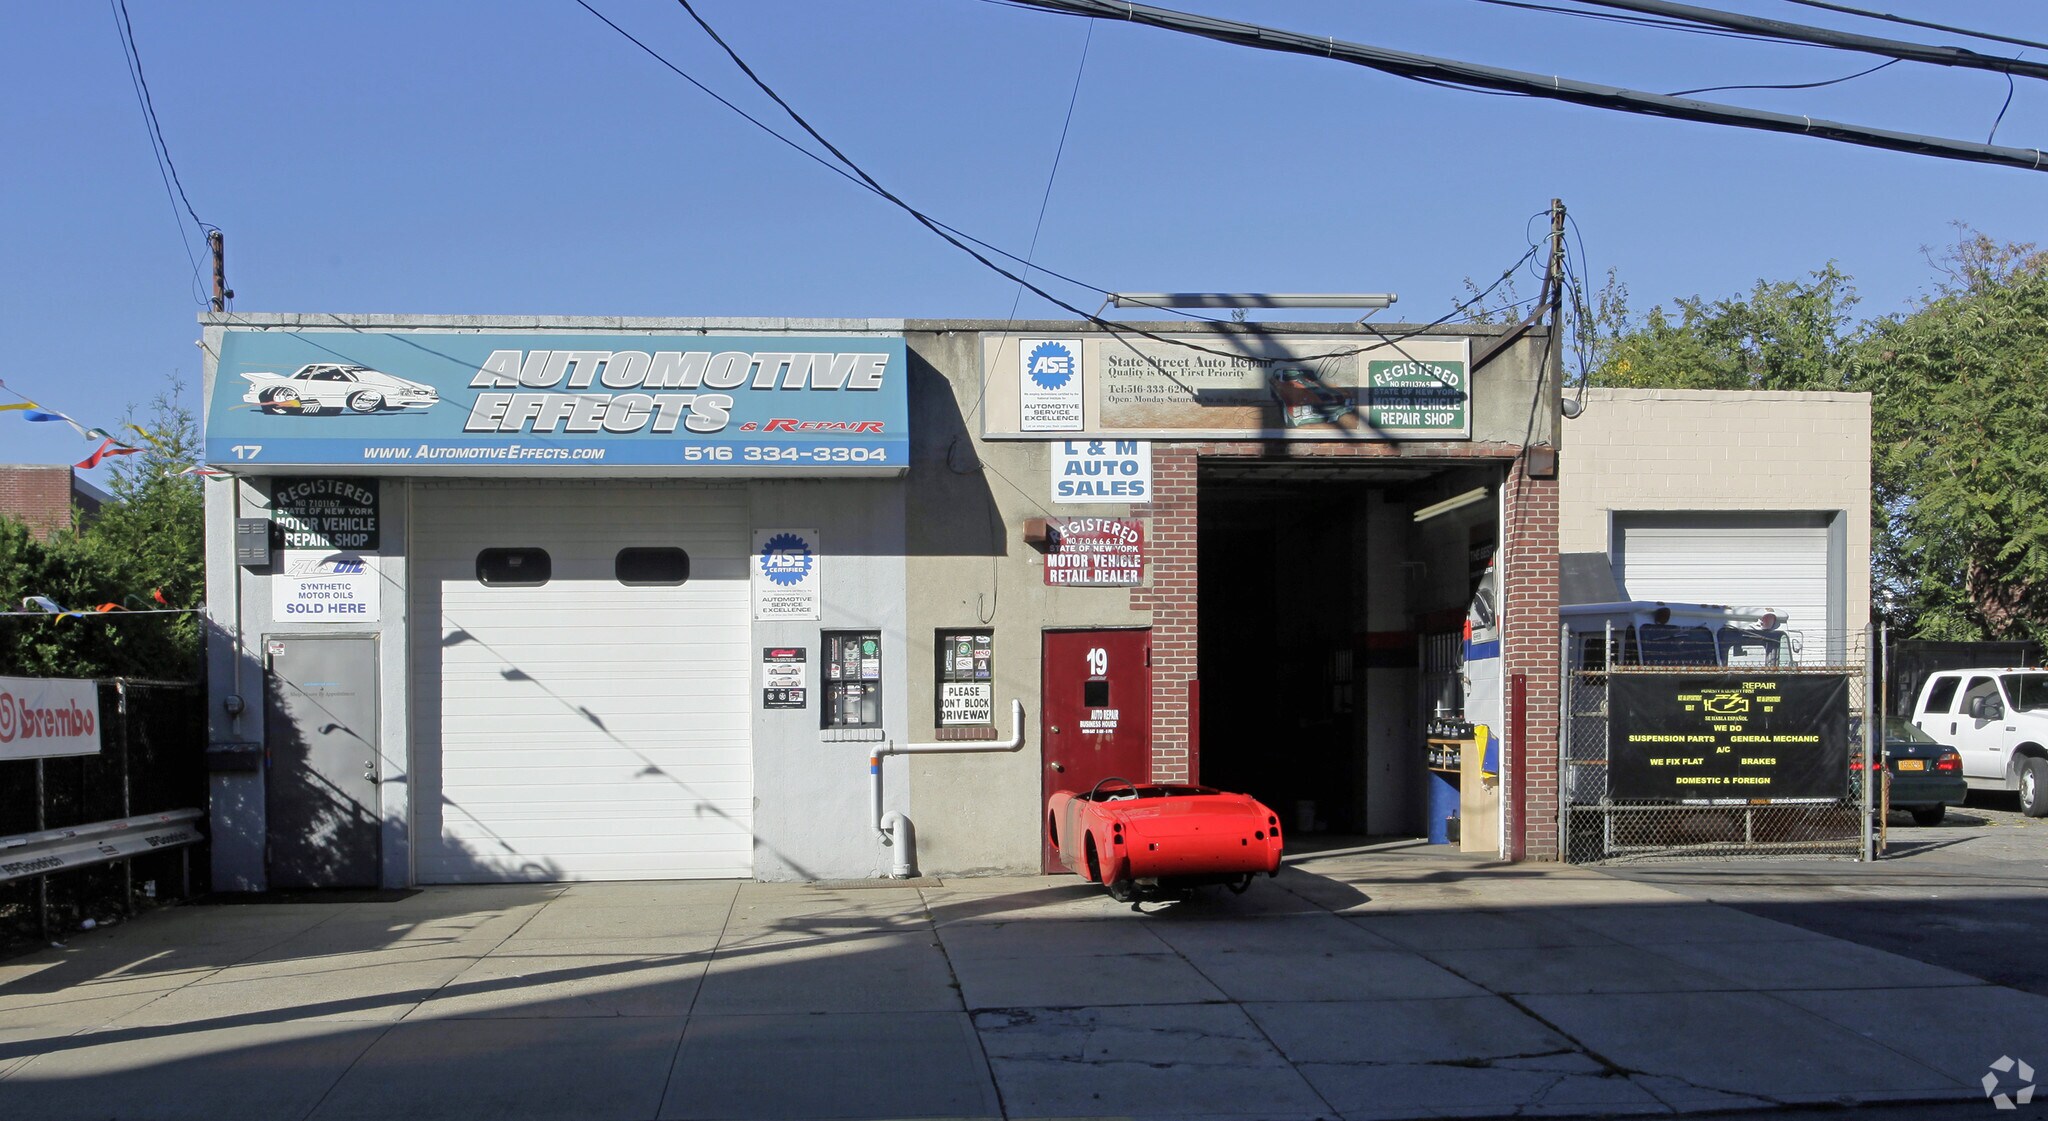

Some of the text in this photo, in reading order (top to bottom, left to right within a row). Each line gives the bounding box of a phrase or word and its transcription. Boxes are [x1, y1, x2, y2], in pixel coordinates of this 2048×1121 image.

[467, 348, 890, 390] AUTOMOTIVE
[1032, 356, 1069, 374] ASE
[1108, 355, 1275, 372] State Street Auto Repair
[1108, 367, 1246, 379] Quality is Our First Priority
[1373, 362, 1460, 387] REGISTERED
[1108, 384, 1194, 394] Tel:516-333-6200
[1108, 395, 1133, 404] Open:
[1373, 397, 1461, 411] MOTOR VEHICLE
[462, 392, 735, 434] EFFECTS
[738, 422, 758, 432] &
[1381, 412, 1455, 425] REPAIR SHOP
[231, 445, 262, 460] 17
[684, 446, 887, 462] 516 334-3304
[1064, 440, 1138, 456] L & M
[1064, 460, 1139, 476] AUTO
[276, 479, 374, 506] REGISTERED
[1057, 480, 1146, 496] SALES
[277, 507, 374, 515] STATE OF NEW YORK
[309, 500, 341, 508] 7101167
[276, 517, 375, 531] MOTOR VEHICLE
[1049, 518, 1139, 543] REGISTERED
[285, 533, 369, 547] REPAIR SHOP
[1115, 545, 1139, 553] YORK
[766, 549, 805, 567] ASE
[1047, 554, 1141, 568] MOTOR VEHICLE
[1050, 569, 1139, 583] RETAIL DEALER
[286, 603, 367, 614] SOLD HERE
[1086, 648, 1108, 675] 19
[949, 686, 980, 696] PLEASE
[1742, 682, 1776, 690] REPAIR
[965, 698, 990, 708] BLOCK
[19, 698, 94, 739] brembo
[940, 710, 990, 720] DRIVEWAY
[1091, 709, 1103, 720] AUTO
[1741, 757, 1776, 765] BRAKES
[2, 855, 65, 876] BFGoodrich
